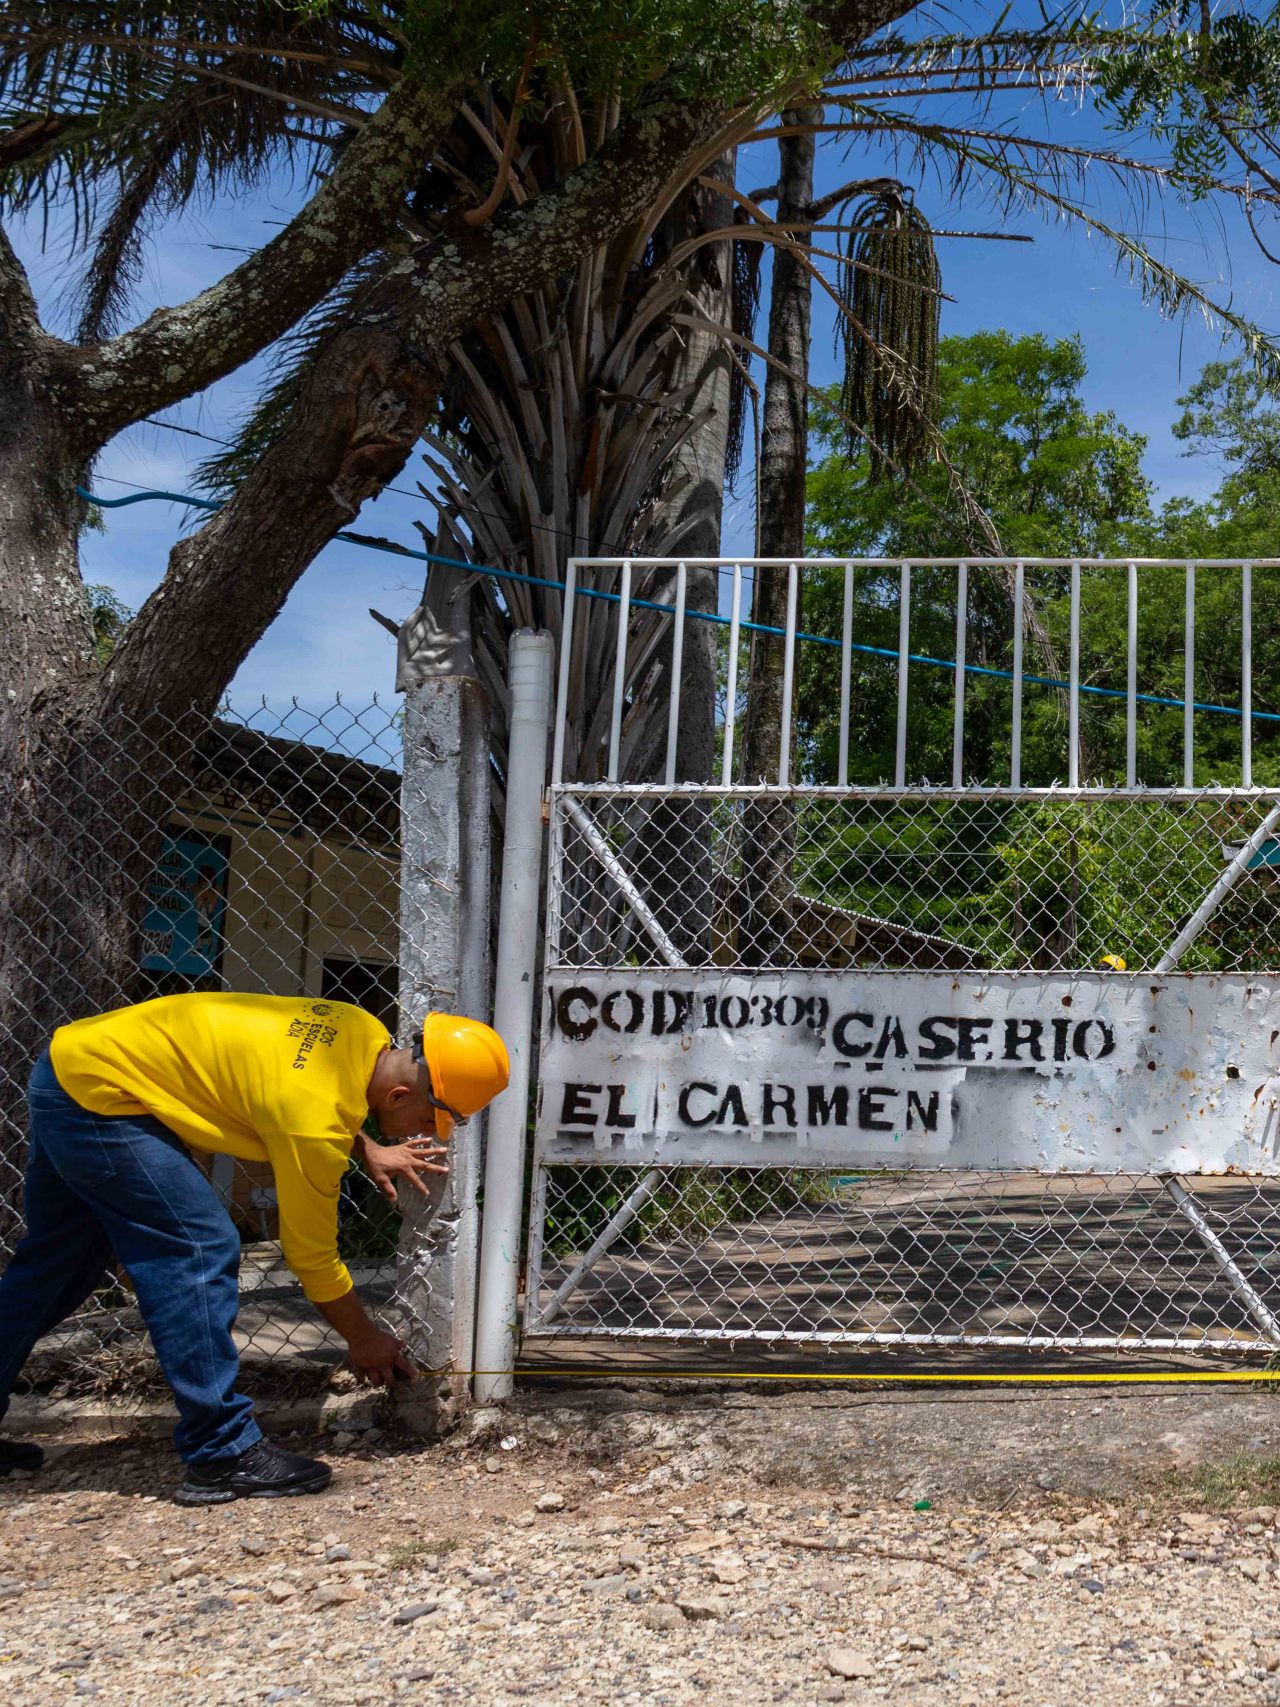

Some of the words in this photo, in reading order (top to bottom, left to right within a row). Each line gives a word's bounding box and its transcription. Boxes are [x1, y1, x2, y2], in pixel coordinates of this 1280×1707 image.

[293, 1023, 322, 1070] ESCUELAS
[319, 1025, 338, 1047] DOS
[557, 986, 688, 1041] COD
[702, 994, 829, 1029] 10309
[832, 1012, 1116, 1061] CASERIO
[560, 1082, 637, 1128] EL
[678, 1082, 939, 1131] CARMEN
